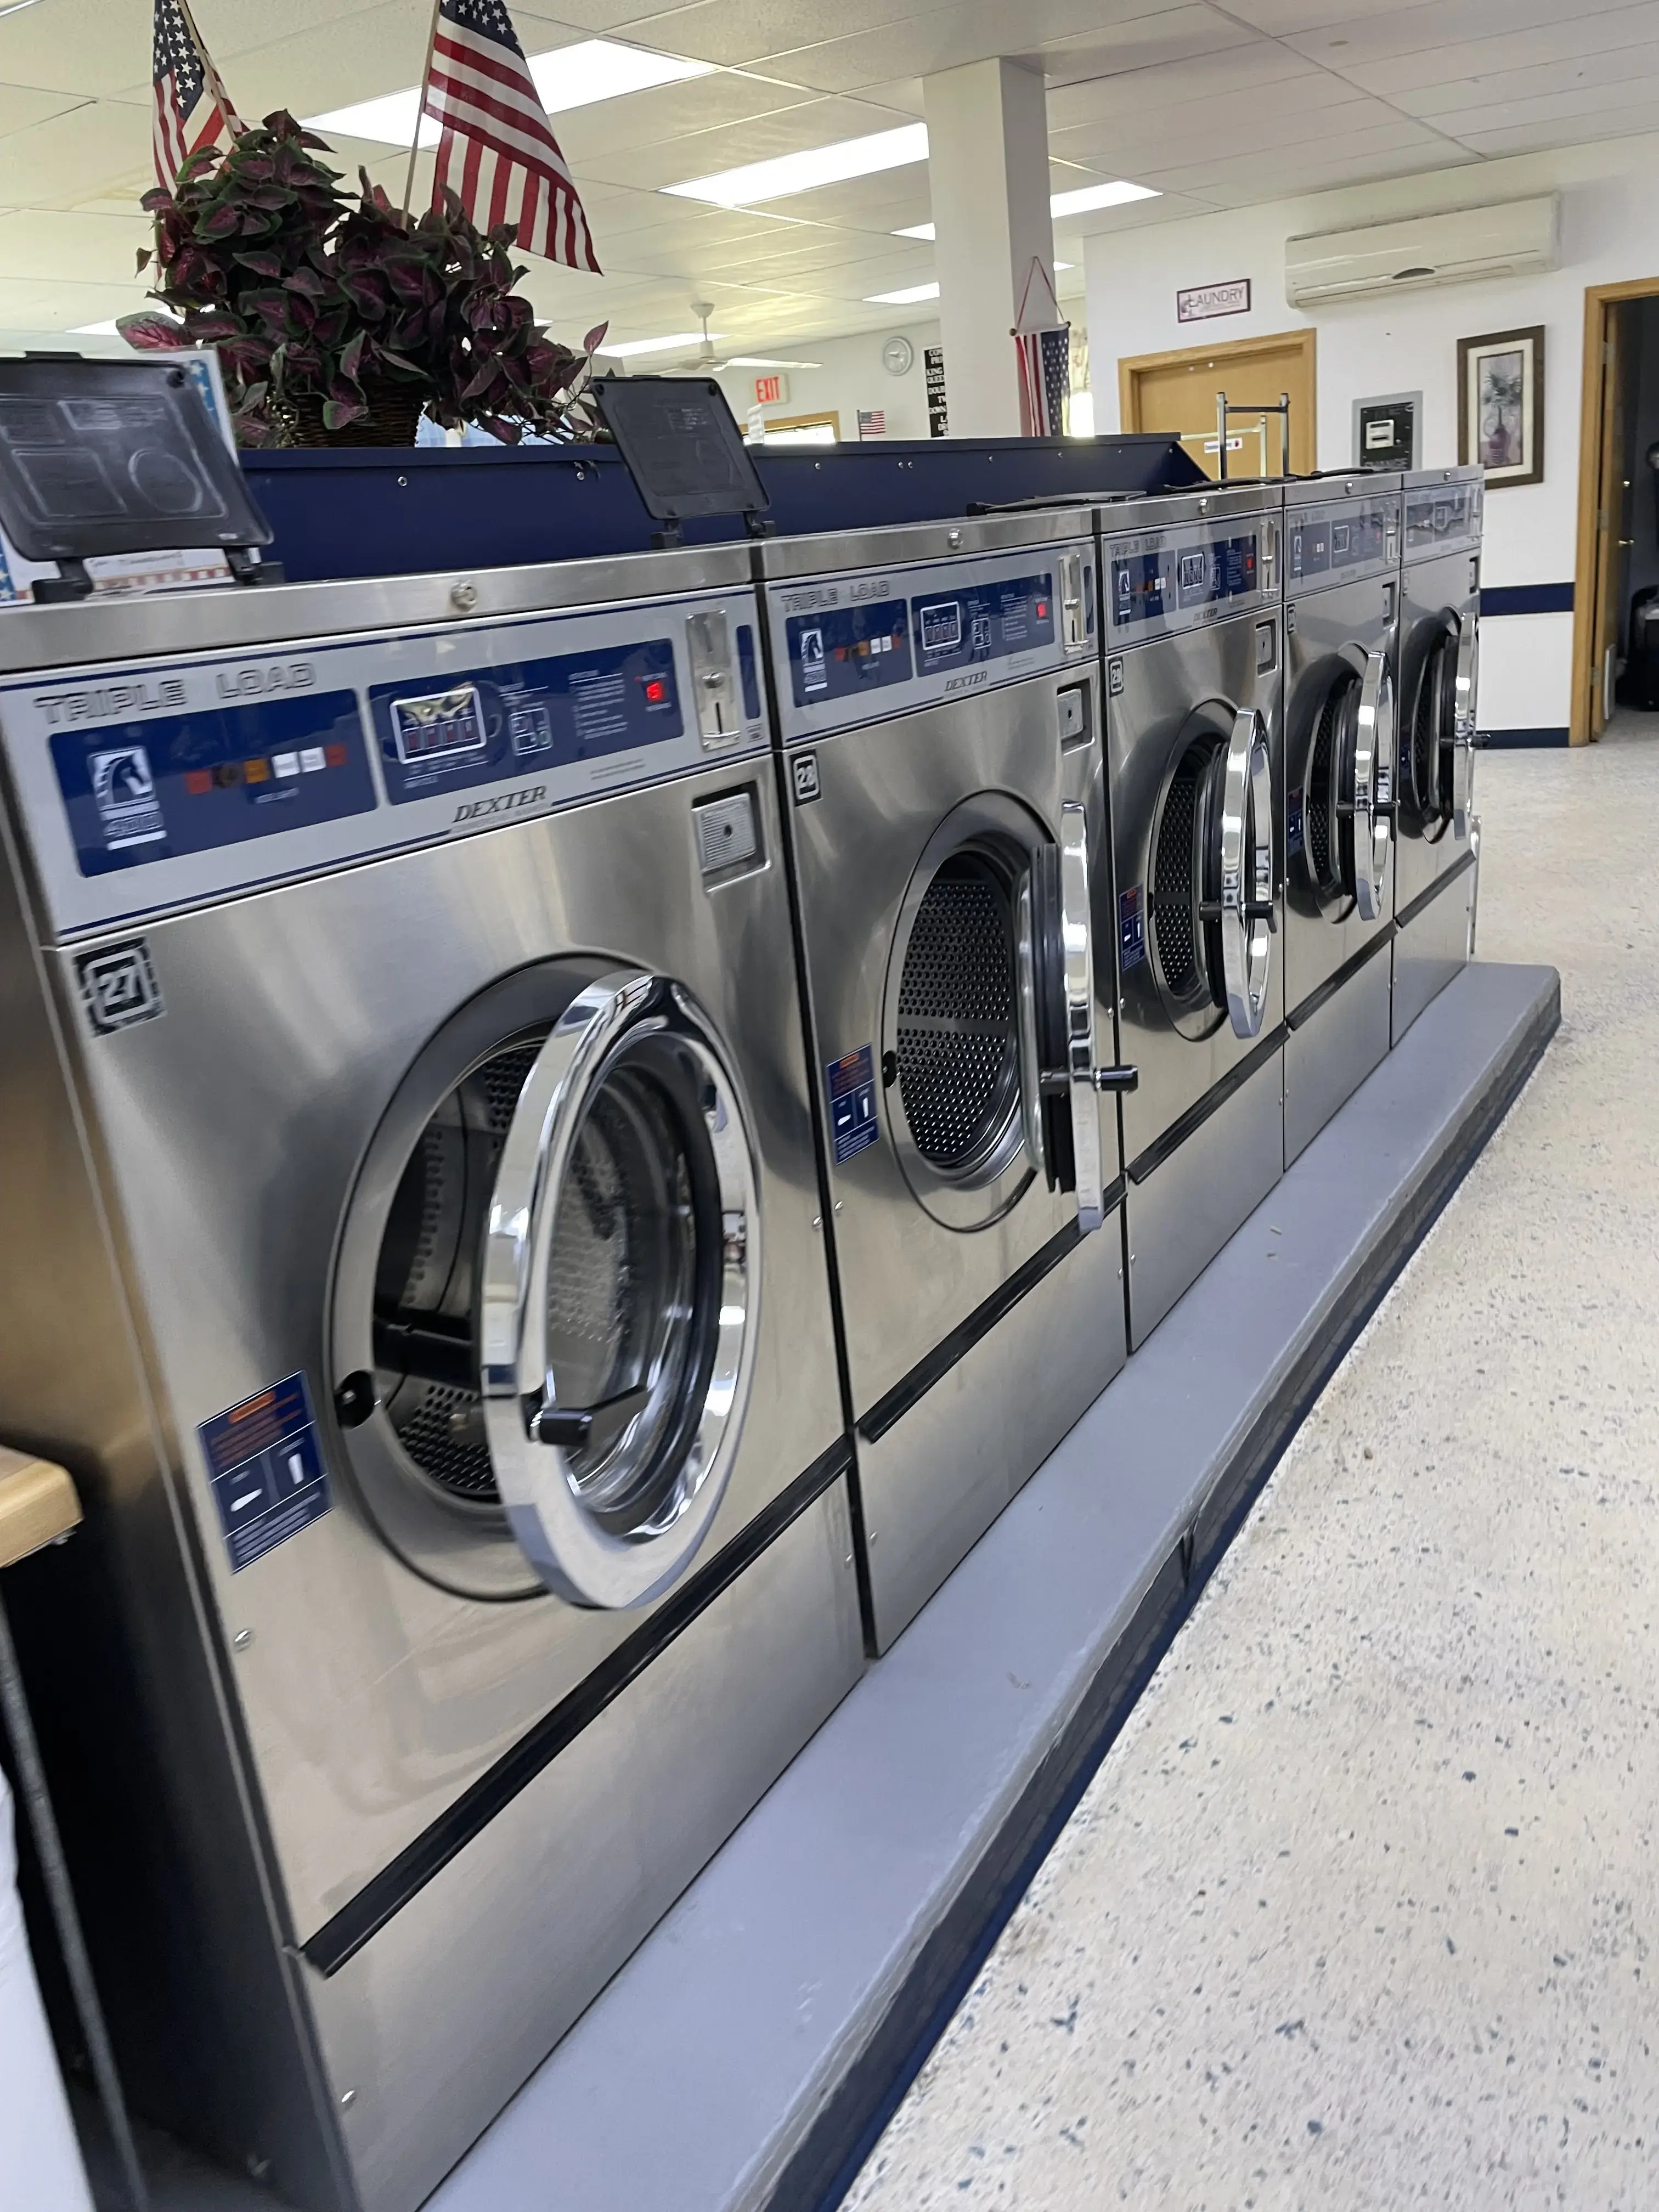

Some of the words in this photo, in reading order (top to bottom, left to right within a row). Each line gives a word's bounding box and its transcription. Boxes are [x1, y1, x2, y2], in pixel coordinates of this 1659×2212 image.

[1188, 286, 1244, 308] LAUNDRY
[755, 376, 780, 403] EXIT
[927, 375, 945, 383] QUEE
[781, 588, 838, 612] TRIPLE
[850, 580, 889, 601] LOAD
[33, 679, 188, 724] TRIPLE
[216, 662, 317, 699] LOAD
[944, 670, 987, 691] DEXTER
[452, 786, 547, 823] DEXTER
[98, 964, 136, 1007] 27
